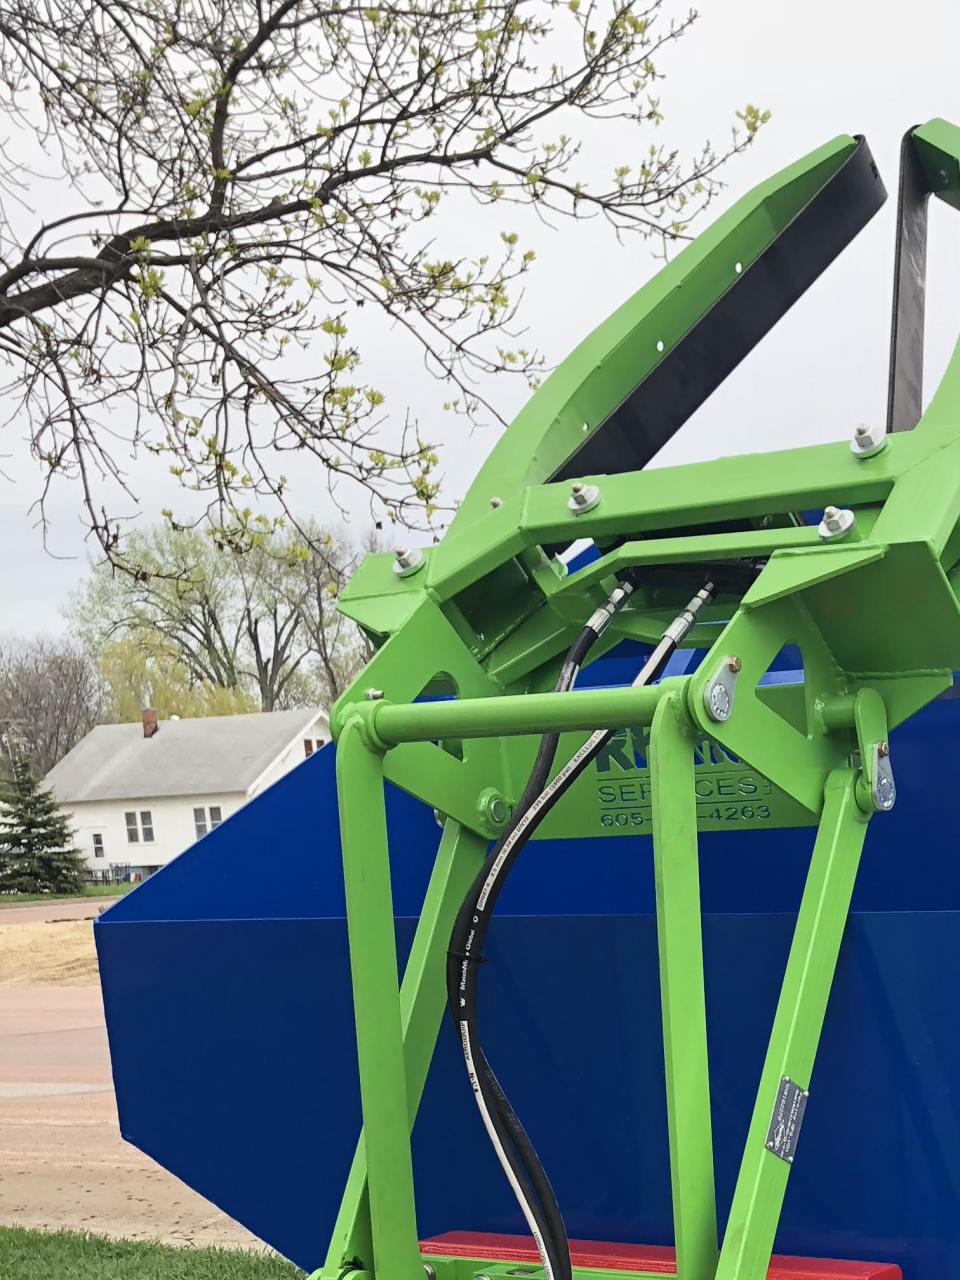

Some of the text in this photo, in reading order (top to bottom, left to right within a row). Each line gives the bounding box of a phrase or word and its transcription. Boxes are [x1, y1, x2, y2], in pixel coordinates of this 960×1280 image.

[598, 776, 758, 803] SECES
[600, 805, 771, 827] 605--4263
[465, 929, 475, 950] Global
